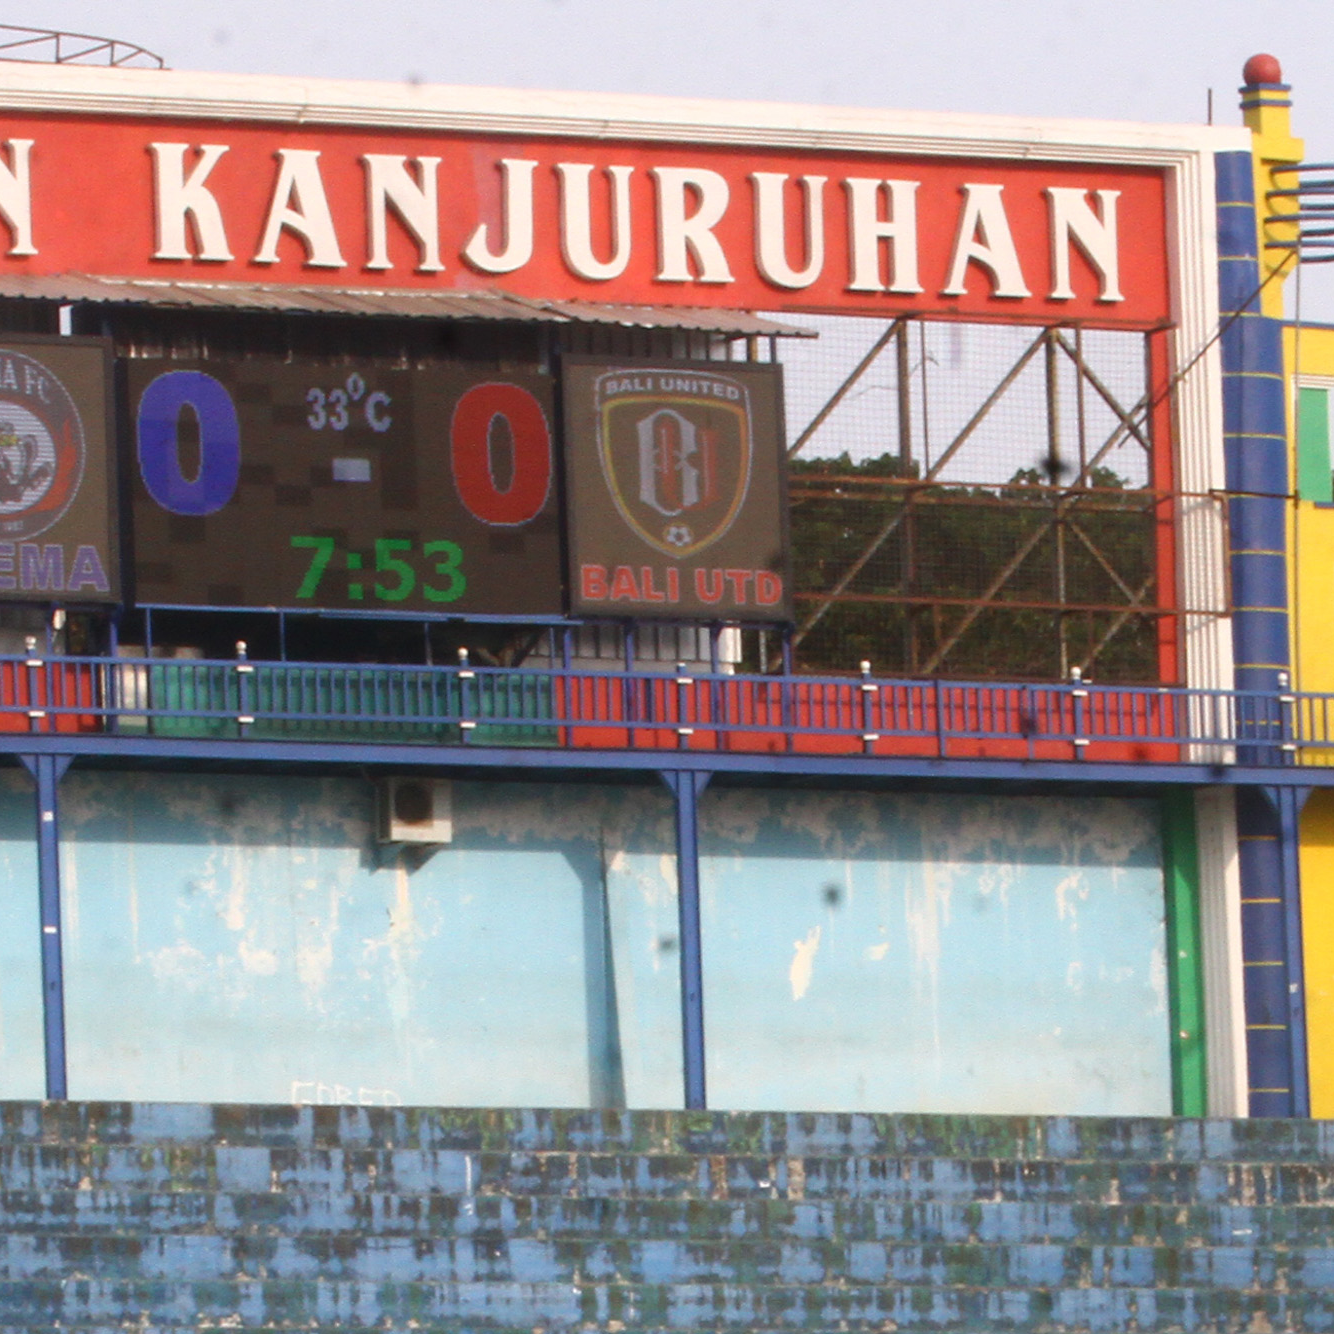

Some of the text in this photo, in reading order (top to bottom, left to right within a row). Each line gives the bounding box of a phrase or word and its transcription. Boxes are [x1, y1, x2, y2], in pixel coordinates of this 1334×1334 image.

[150, 141, 1126, 302] KANJURUHAN
[605, 377, 740, 399] BALI UNITED
[136, 369, 241, 517] 0
[450, 381, 553, 527] 0
[290, 536, 468, 602] 7:53
[581, 564, 784, 606] BALI UTD
